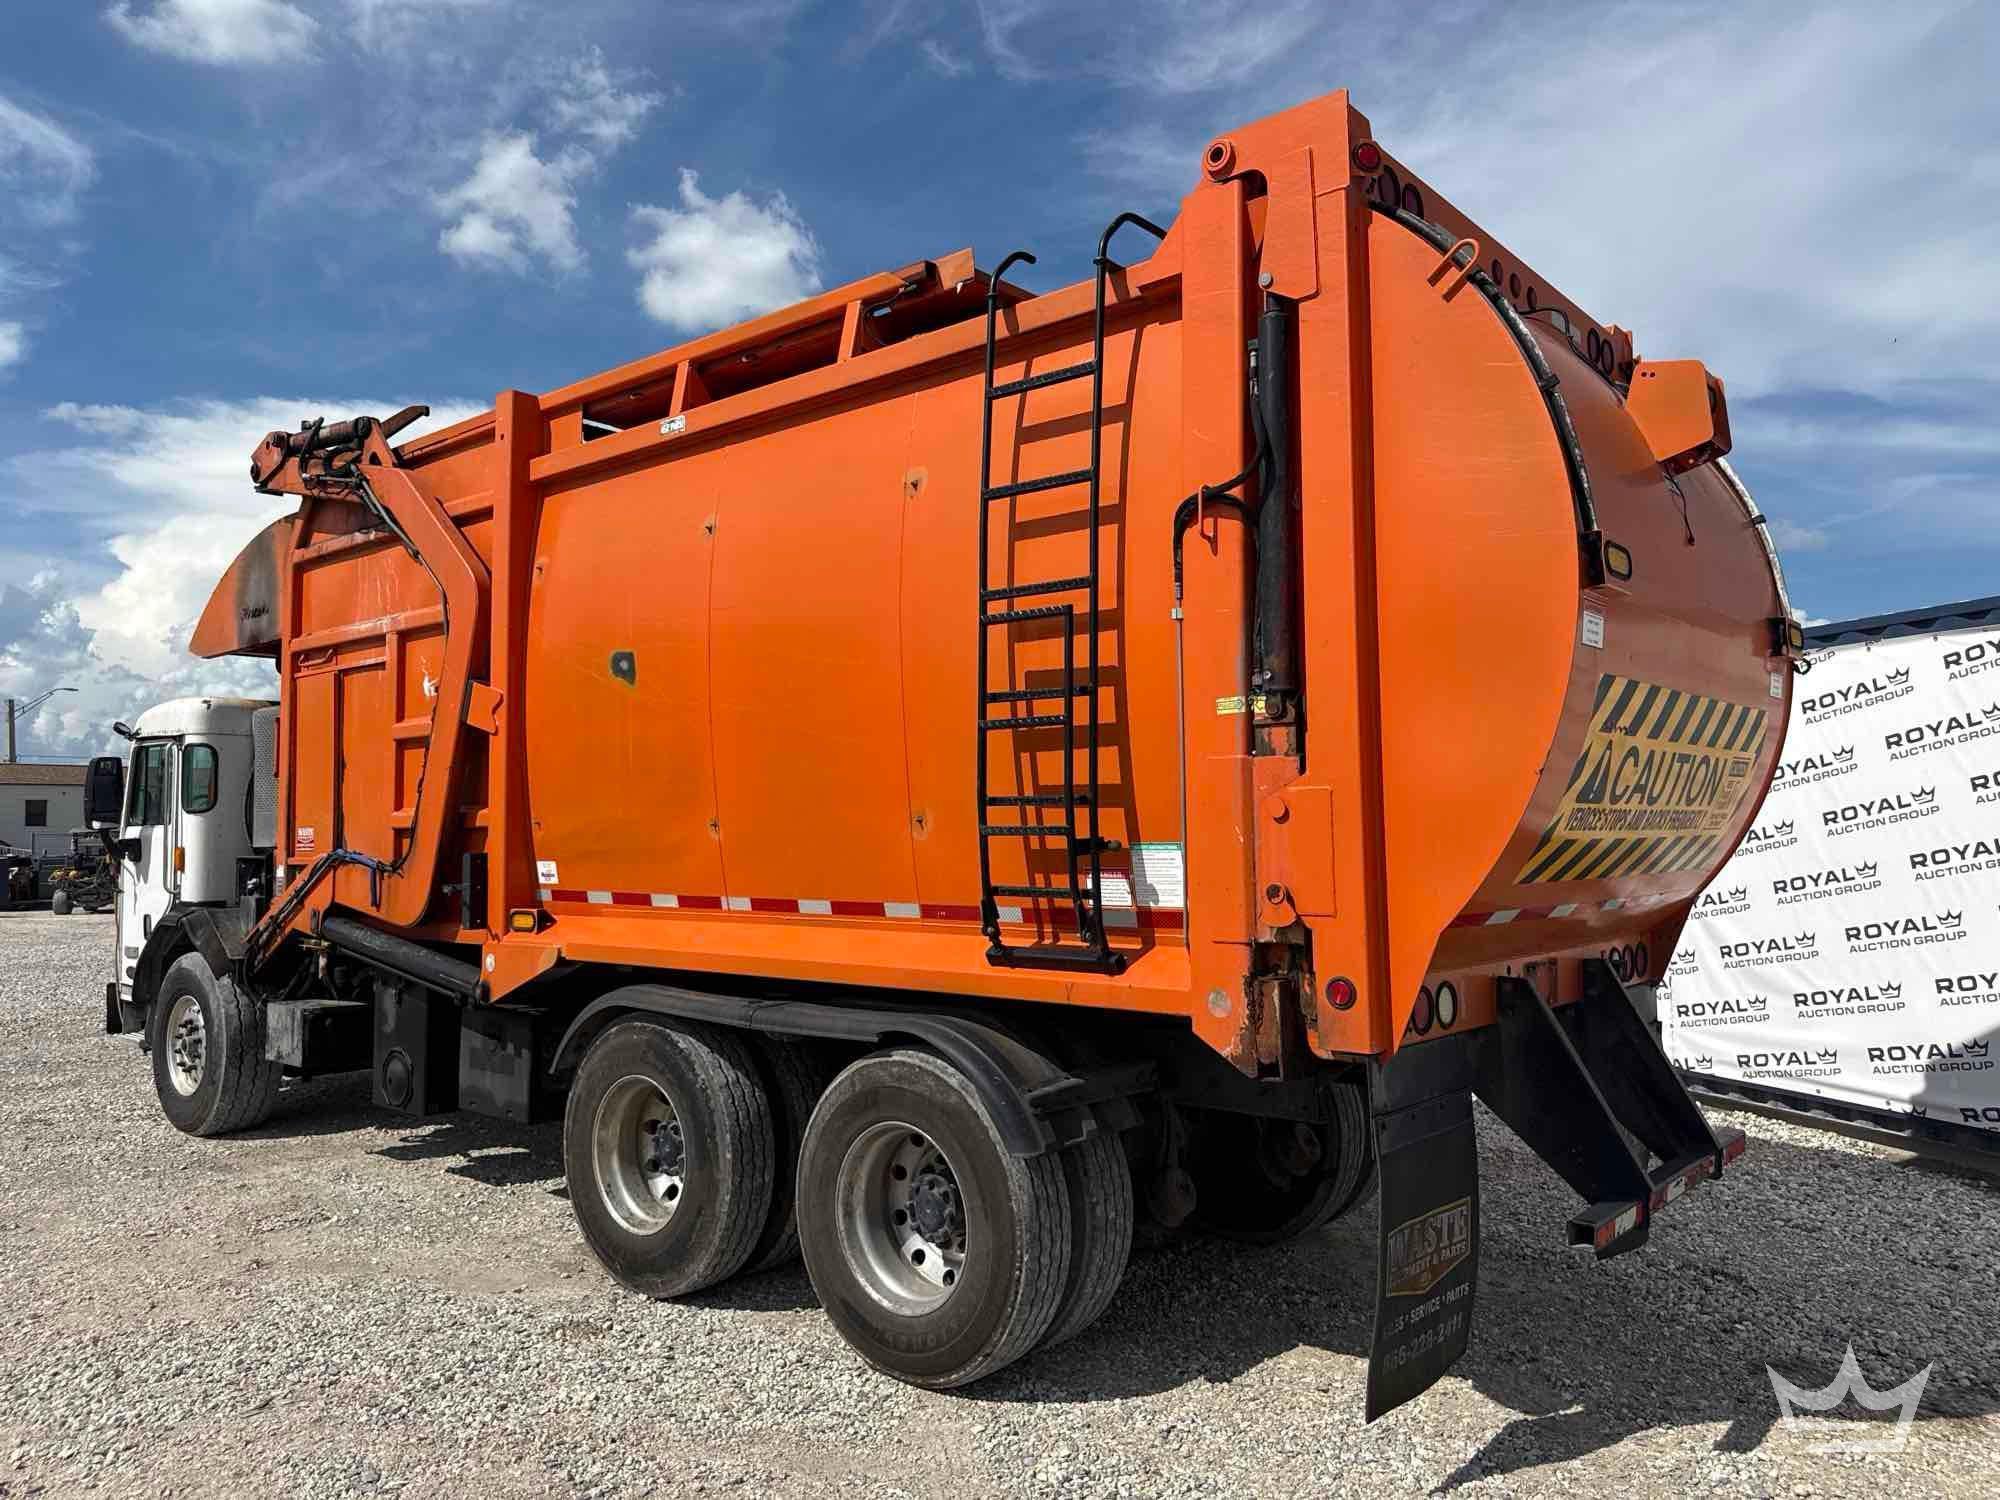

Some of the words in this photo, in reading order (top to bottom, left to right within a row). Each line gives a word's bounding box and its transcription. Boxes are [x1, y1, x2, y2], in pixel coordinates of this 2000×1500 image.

[1943, 638, 2000, 669] ROY
[1948, 658, 2000, 681] AUCTIO
[1801, 677, 1887, 714] ROYAL
[1805, 701, 1863, 725] AUCTION
[1865, 685, 1915, 707] GROUP
[1885, 712, 1983, 750] ROYAL
[1889, 737, 1955, 761] AUCTION
[1958, 724, 2000, 743] GROU
[1609, 745, 1728, 806] CAUTION
[1768, 776, 1810, 794] CTION
[1812, 763, 1859, 781] GROUP
[1773, 754, 1833, 780] OYAL
[1822, 794, 1912, 826] ROYAL
[1827, 817, 1886, 838] AUCTION
[1888, 805, 1940, 824] GROUP
[1755, 837, 1799, 853] GROUP
[1773, 867, 1856, 894] ROYAL
[1914, 862, 1983, 882] AUCTION
[1776, 888, 1832, 906] AUCTION
[1835, 880, 1882, 897] GROUP
[1711, 903, 1751, 917] GROUP
[1845, 915, 1938, 942] ROYAL
[1719, 936, 1796, 959] ROYAL
[1849, 938, 1912, 954] AUCTION
[1914, 930, 1967, 947] GROUP
[1723, 956, 1774, 970] AUCTION
[1775, 950, 1819, 963] GROUP
[1935, 972, 1999, 994] ROY
[1793, 986, 1879, 1007] ROYAL
[1940, 992, 2000, 1007] AUCTIO
[1677, 999, 1748, 1018] ROYAL
[1797, 1006, 1855, 1020] AUCTION
[1857, 1001, 1906, 1015] GROUP
[1680, 1017, 1728, 1028] AUCTION
[1729, 1014, 1770, 1025] GROUP
[1737, 1050, 1817, 1069] ROYAL
[1867, 1042, 1962, 1063] ROYAL
[1742, 1069, 1793, 1079] AUCTION
[1795, 1067, 1842, 1078] GROUP
[1872, 1063, 1937, 1075] AUCTION
[1939, 1060, 1994, 1073] GROUP
